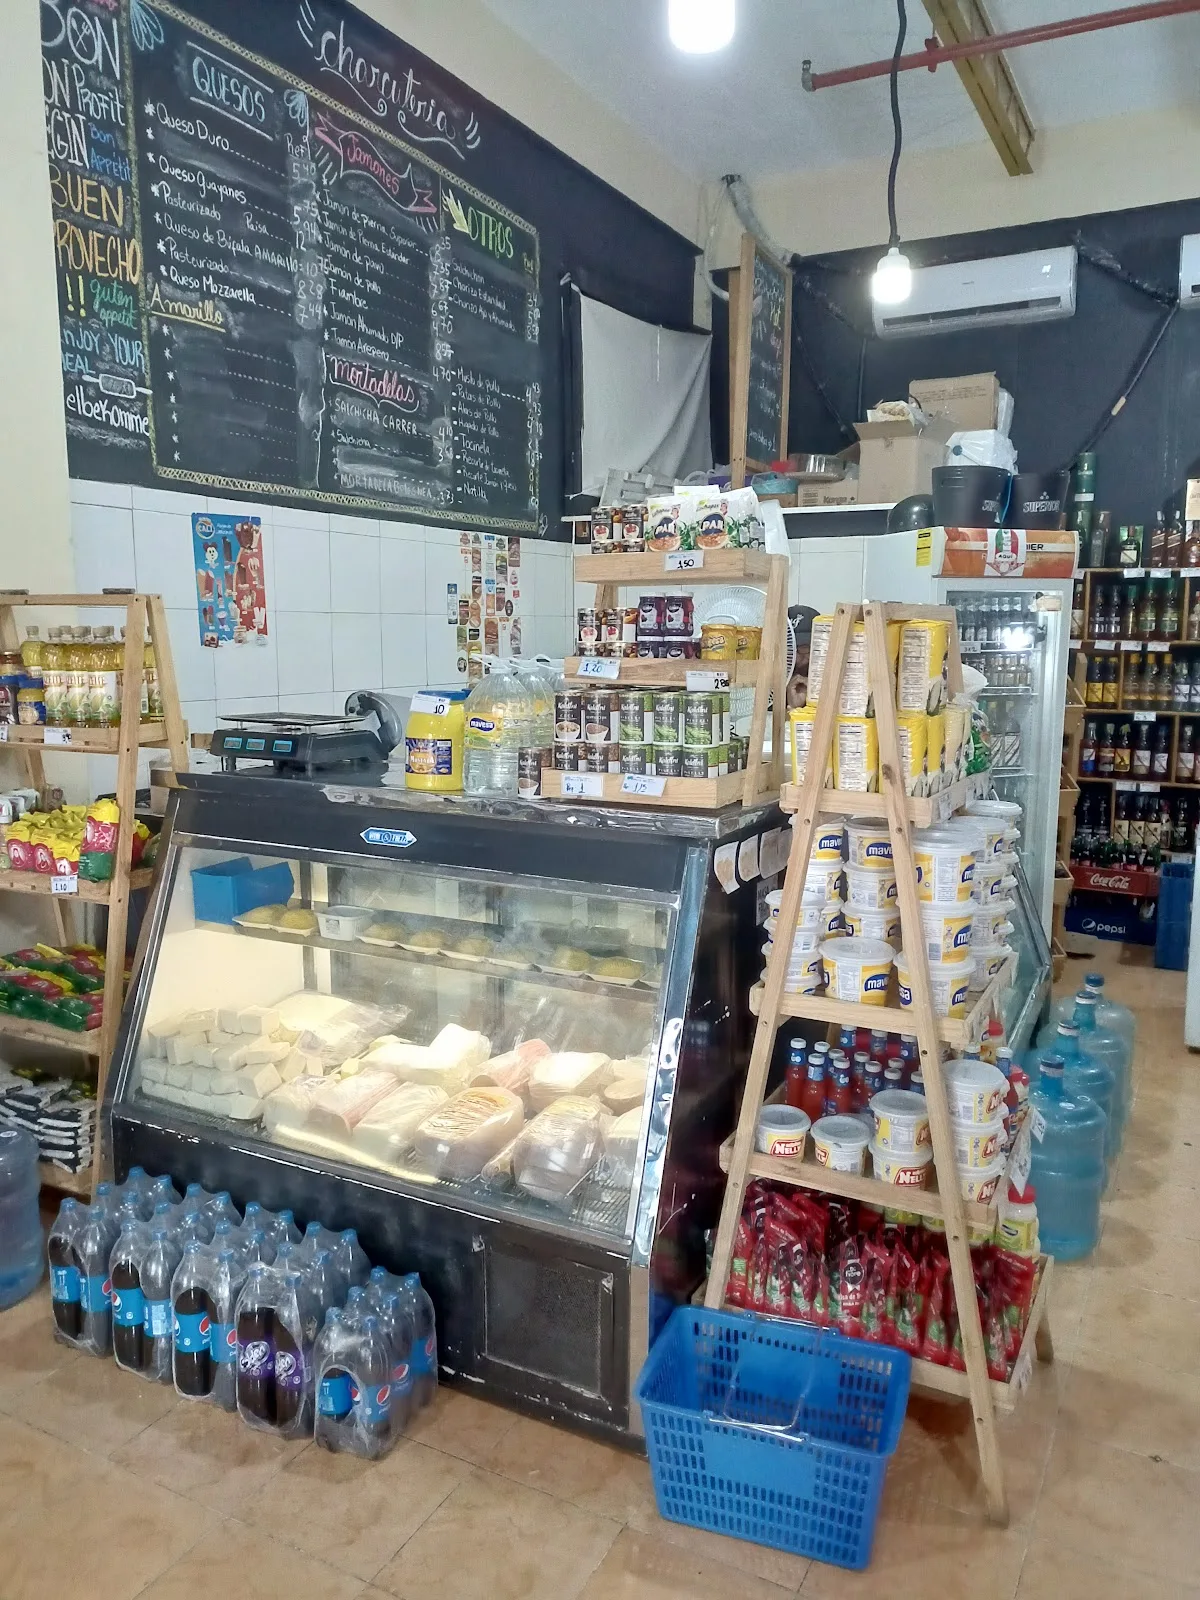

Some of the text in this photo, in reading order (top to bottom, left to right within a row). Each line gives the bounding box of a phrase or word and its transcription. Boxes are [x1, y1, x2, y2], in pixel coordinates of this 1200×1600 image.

[192, 56, 266, 123] QUESOS
[46, 108, 89, 170] GIN
[156, 103, 194, 136] Queso
[198, 119, 230, 151] Duro
[158, 155, 194, 184] Queso
[346, 134, 400, 195] Jamones
[50, 162, 124, 228] BUEN
[159, 180, 222, 221] Pasteurizado
[164, 212, 200, 240] Queso
[203, 225, 215, 245] de
[467, 206, 514, 259] OTROS
[53, 218, 141, 285] ROVECHO
[89, 278, 134, 313] guten
[150, 282, 223, 326] Amarillo
[169, 264, 200, 290] Queso
[202, 274, 257, 306] Mozzarella
[108, 333, 147, 374] YOUR
[1022, 500, 1061, 514] SUPERIOR
[1096, 923, 1127, 934] pepsi
